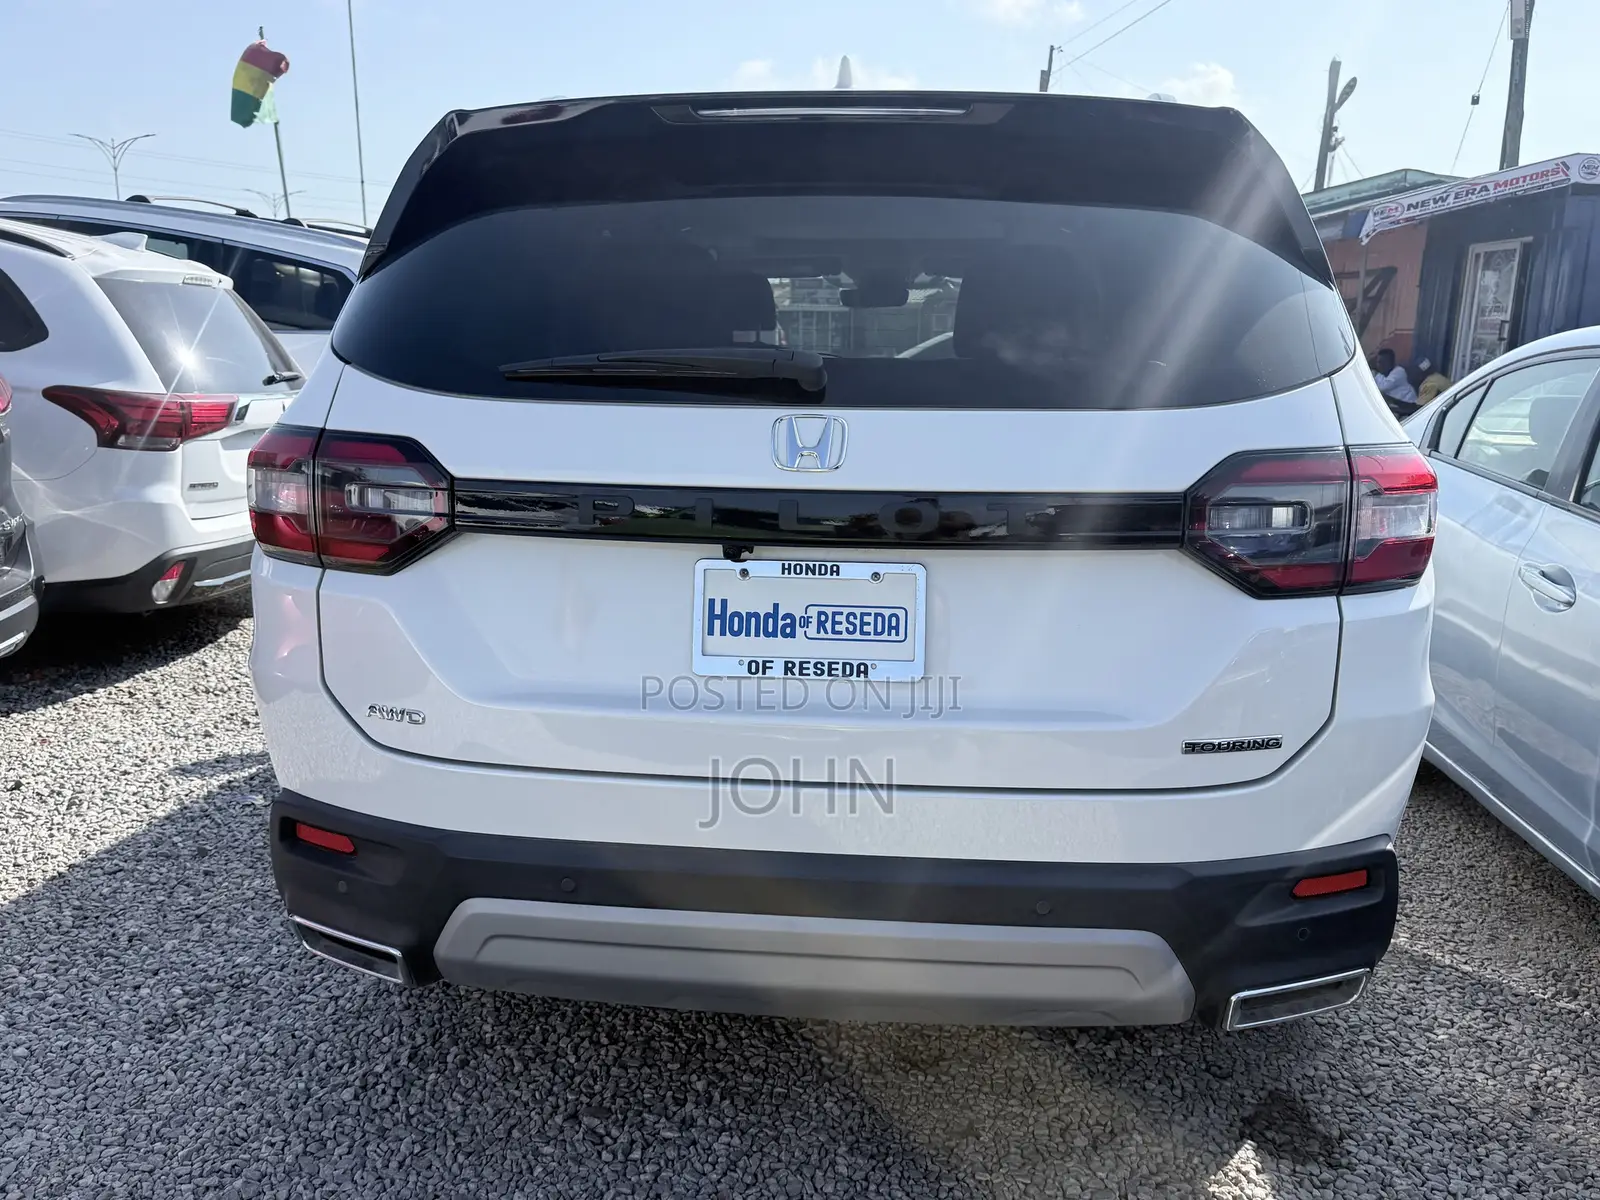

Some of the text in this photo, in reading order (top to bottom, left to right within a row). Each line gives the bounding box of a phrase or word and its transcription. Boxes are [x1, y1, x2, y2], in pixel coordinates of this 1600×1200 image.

[1406, 194, 1450, 211] NEW
[1453, 184, 1490, 200] ERA
[1493, 166, 1562, 190] MOTORS
[578, 494, 1045, 536] PILOT
[781, 562, 840, 577] HONDA
[707, 598, 901, 639] Honda OF RESEDA
[747, 660, 868, 678] OF RESEDA
[366, 704, 426, 725] AWD
[1184, 738, 1281, 753] TOURING
